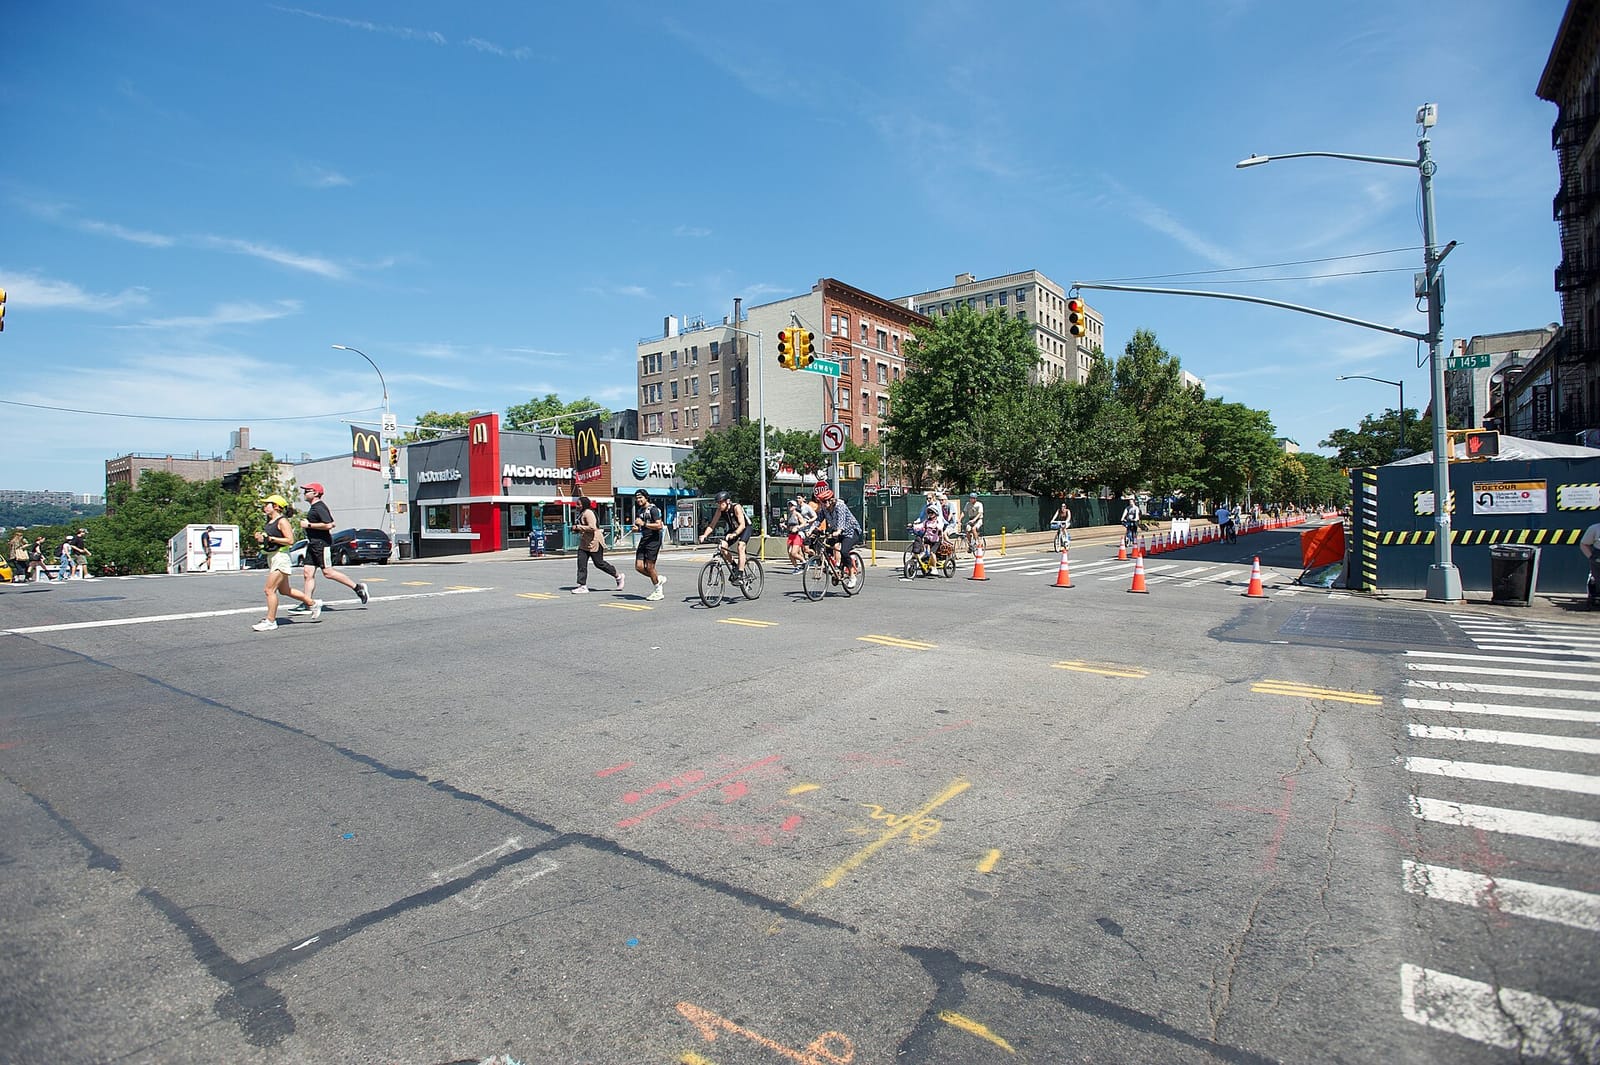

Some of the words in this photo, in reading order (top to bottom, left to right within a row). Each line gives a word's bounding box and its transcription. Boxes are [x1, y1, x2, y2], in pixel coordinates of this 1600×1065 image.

[1448, 358, 1457, 368] W
[1460, 356, 1477, 368] 145
[384, 423, 397, 431] 25
[650, 461, 677, 475] AT&T
